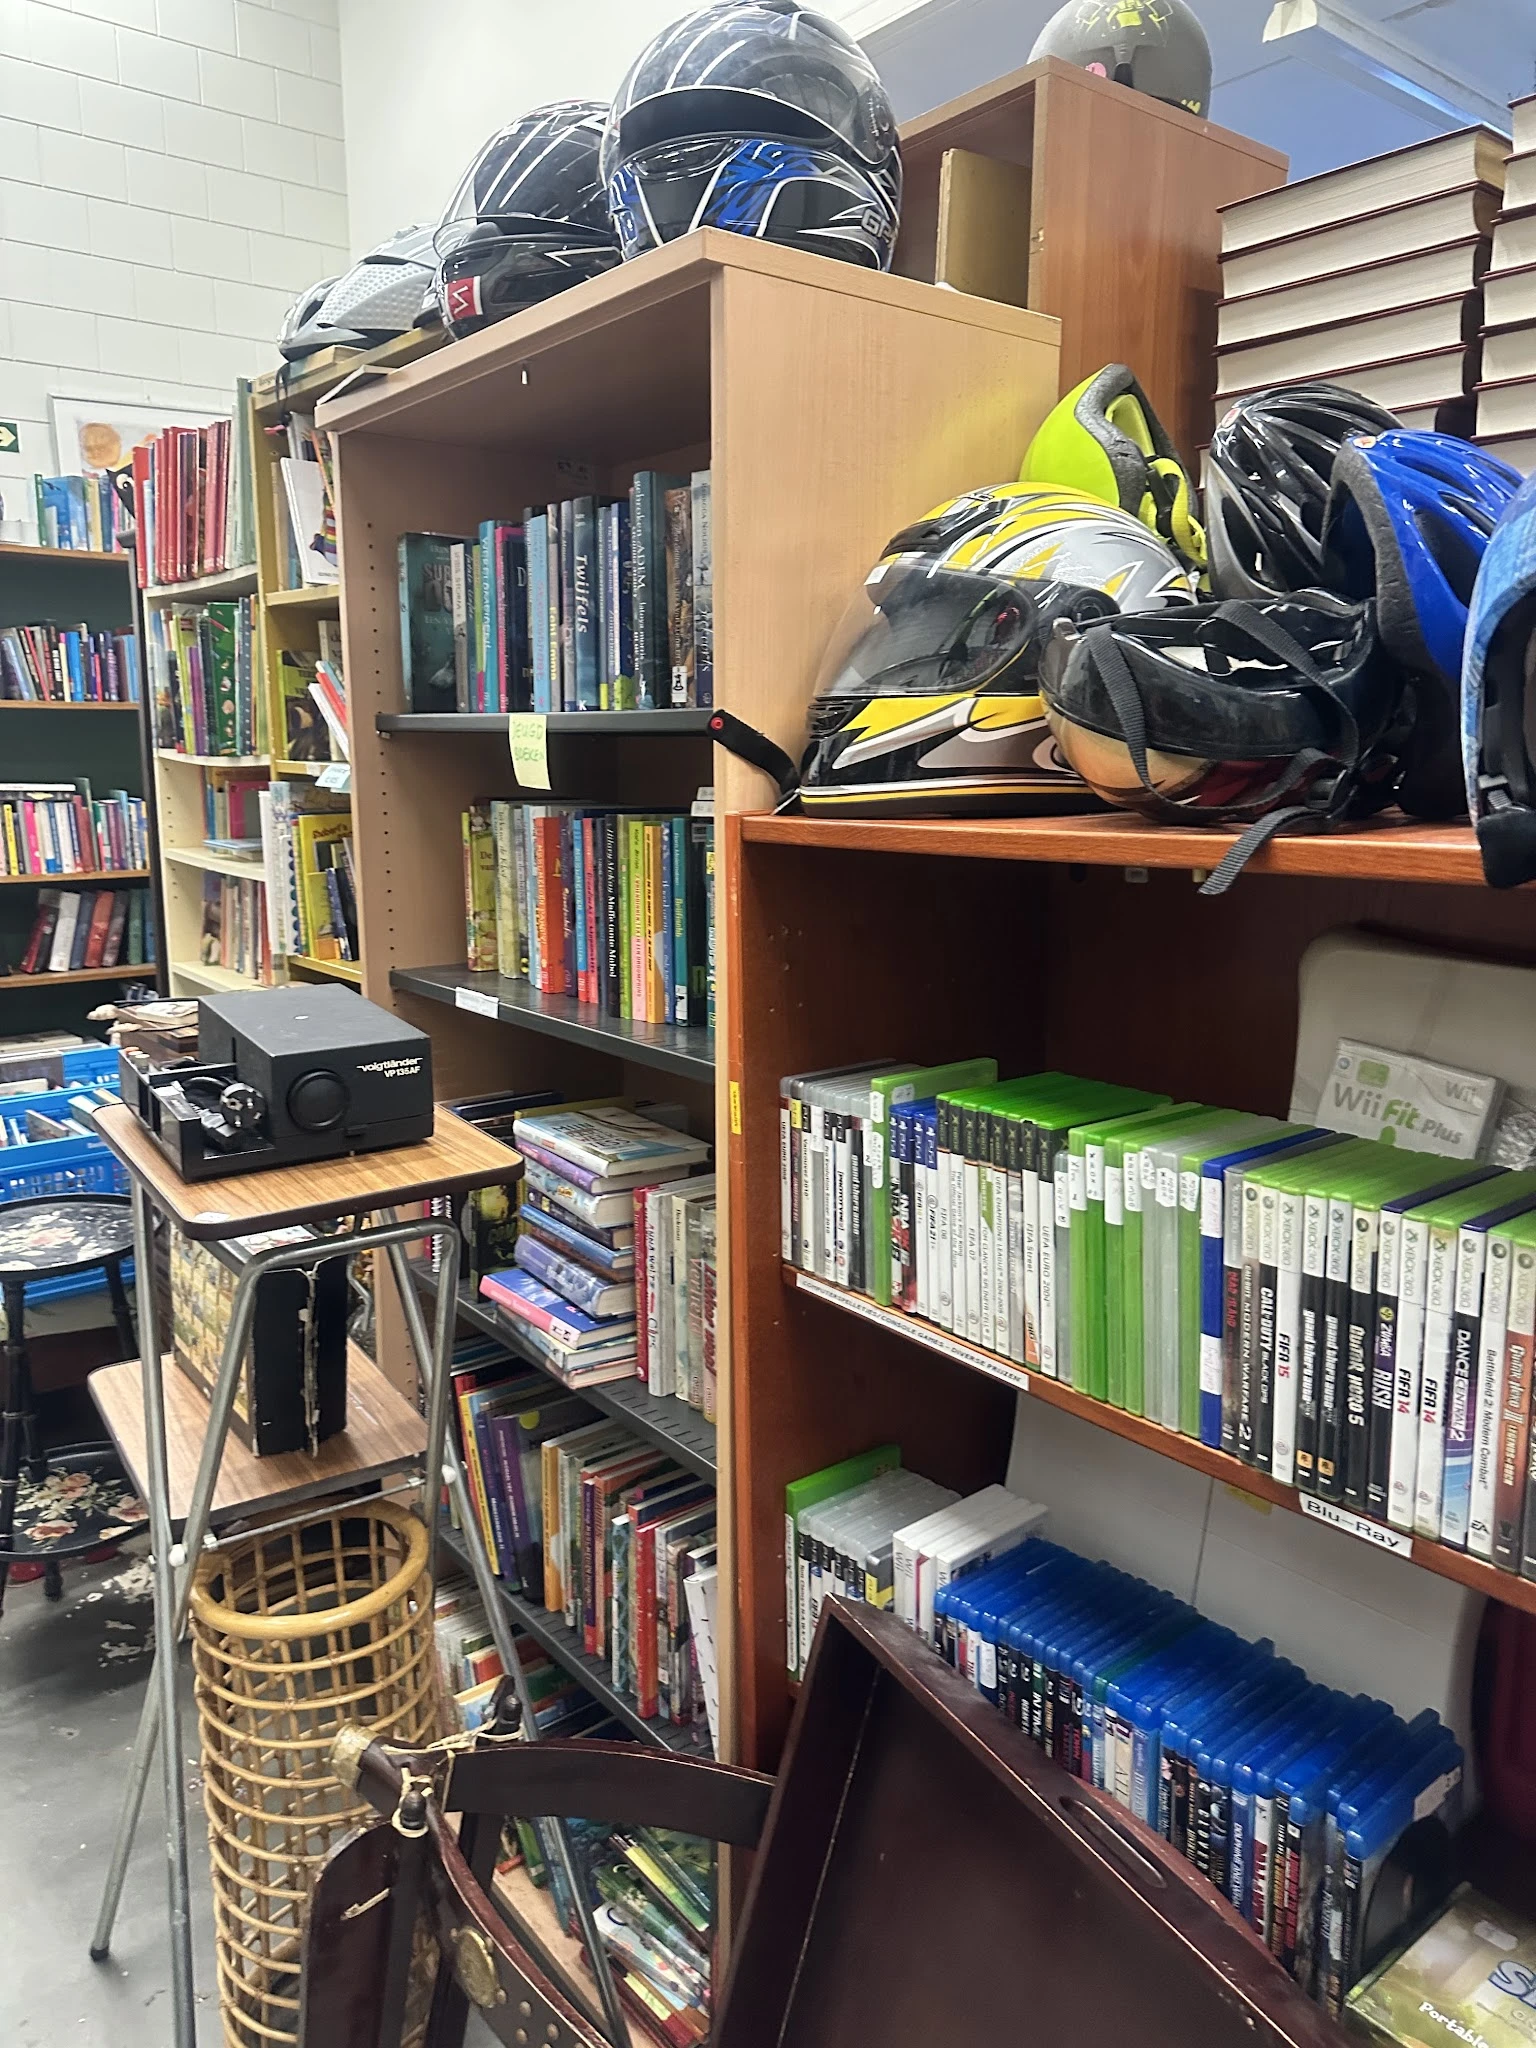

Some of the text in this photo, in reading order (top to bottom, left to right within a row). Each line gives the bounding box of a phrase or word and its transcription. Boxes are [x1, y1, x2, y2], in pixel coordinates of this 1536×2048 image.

[636, 541, 646, 589] ADEM
[576, 555, 588, 633] Twijfels
[606, 829, 615, 859] Hilary
[1333, 1082, 1463, 1145] Wii Fit Plus
[1445, 1080, 1477, 1102] Wii
[899, 1132, 907, 1157] PS4
[995, 1176, 1004, 1241] UEFA CHAMPIONS
[930, 1230, 936, 1240] 21
[968, 1228, 976, 1260] FIFA 07
[1026, 1223, 1035, 1273] FIFA Street
[1042, 1226, 1050, 1249] UEFA
[1043, 1252, 1051, 1278] EURO
[918, 1331, 944, 1348] GAMES
[951, 1346, 986, 1368] DIVERSE
[1242, 1302, 1251, 1358] MODERN
[1260, 1287, 1273, 1404] CALL DUTY BLACK OPS
[1278, 1333, 1290, 1378] FIFA 15
[1301, 1308, 1315, 1402] grand theft auto
[1323, 1315, 1338, 1408] grand theft auto
[1347, 1324, 1365, 1426] GUITAR HERO 5
[1372, 1323, 1392, 1410] ZUMBA RUSH
[1484, 1349, 1497, 1397] Battlefield
[1241, 1363, 1250, 1421] WARFARE
[1397, 1368, 1410, 1414] FIFA 14
[1423, 1378, 1437, 1424] FIFA 14
[1449, 1329, 1471, 1442] DANCE CENTRAL 2
[1484, 1399, 1495, 1409] 2:
[1238, 1423, 1252, 1440] 2
[1480, 1411, 1493, 1446] Modern
[1504, 1425, 1516, 1458] LEGENDS
[1307, 1500, 1400, 1548] Blu-Ray
[1033, 1692, 1041, 1706] IN
[1419, 2001, 1489, 2048] Portable
